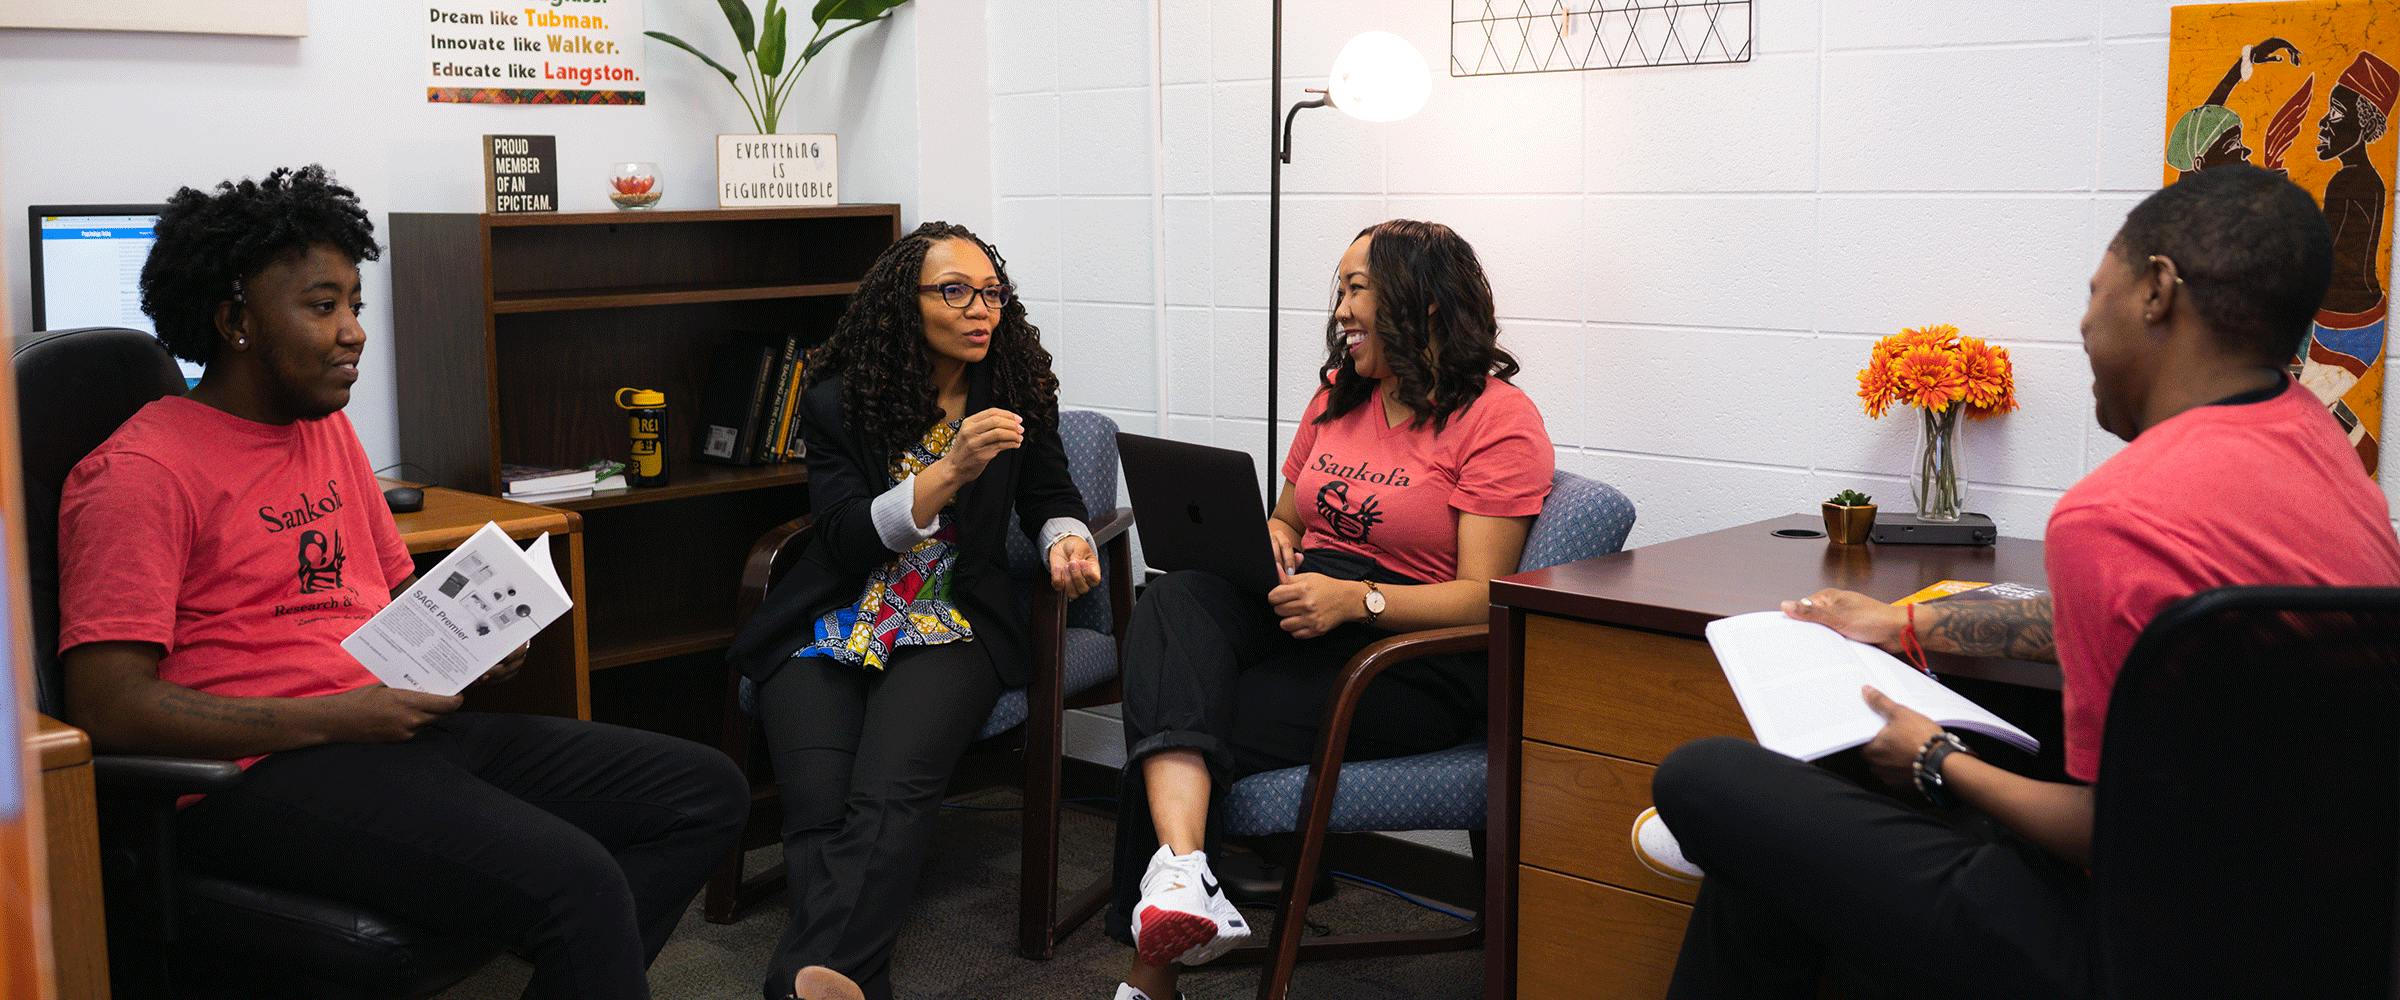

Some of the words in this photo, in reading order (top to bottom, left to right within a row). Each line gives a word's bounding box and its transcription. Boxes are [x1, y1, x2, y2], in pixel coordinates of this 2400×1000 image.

[430, 9, 484, 25] Dream
[490, 11, 518, 26] like
[524, 8, 609, 29] Tubman.
[431, 34, 505, 51] Innovate
[514, 37, 541, 51] like
[546, 35, 619, 55] Walker.
[432, 62, 501, 78] Educate
[508, 64, 536, 78] like
[544, 61, 640, 86] Langston.
[494, 138, 529, 155] PROUD
[495, 157, 540, 174] MEMBER
[497, 176, 510, 193] OF
[511, 176, 526, 193] AN
[497, 195, 520, 212] EPIC
[520, 194, 552, 211] TEAM.
[641, 418, 659, 432] REI
[1310, 453, 1411, 487] Sankofa
[274, 596, 339, 617] Research
[412, 589, 440, 614] SAGE
[437, 610, 469, 641] Premier
